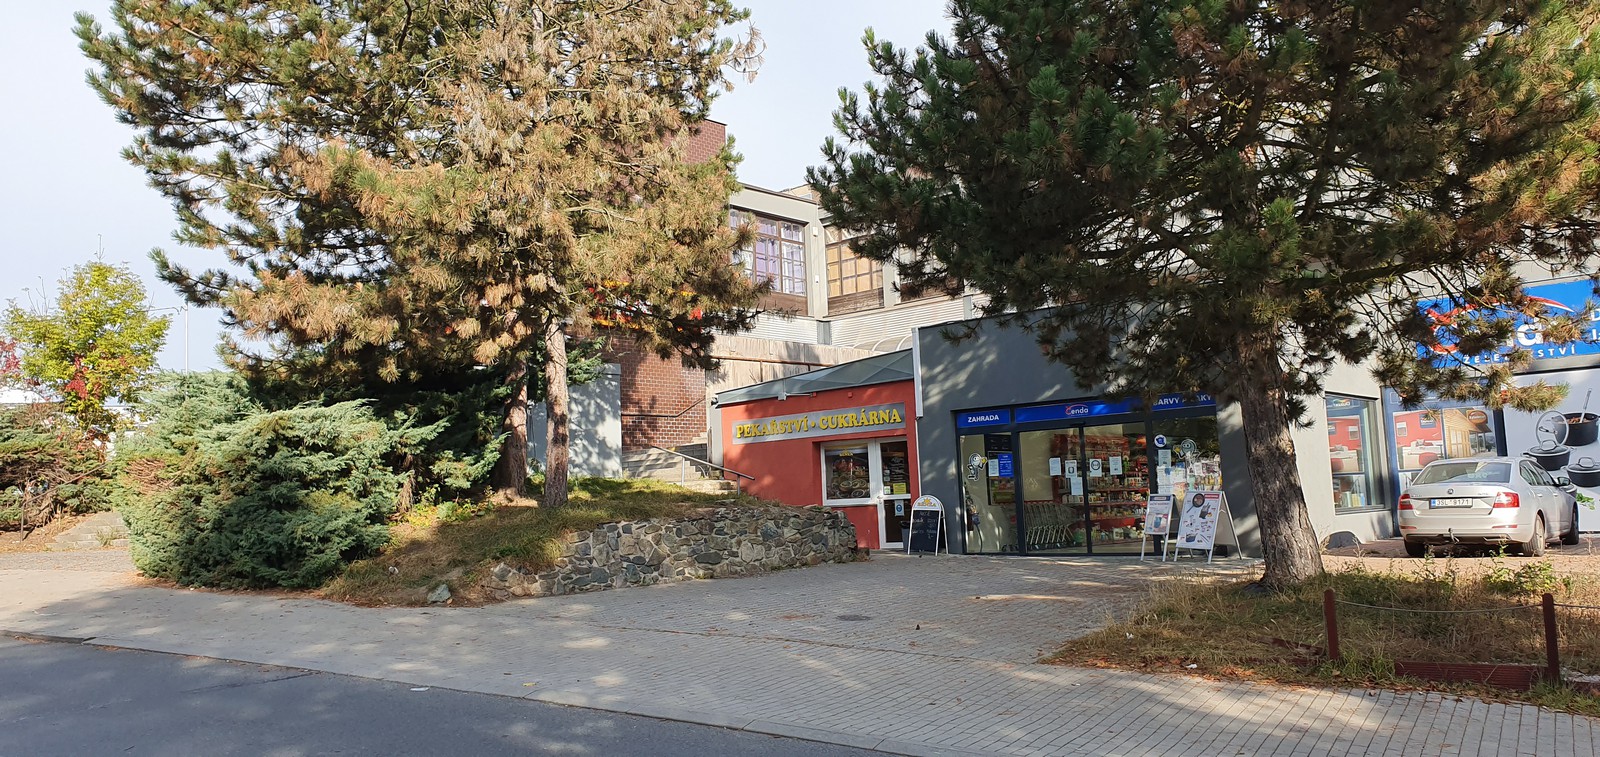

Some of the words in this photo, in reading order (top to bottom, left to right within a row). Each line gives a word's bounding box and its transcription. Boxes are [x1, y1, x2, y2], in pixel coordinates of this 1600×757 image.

[1463, 344, 1575, 364] ŽELESTVÍ
[1153, 397, 1180, 406] ARVY
[736, 416, 808, 438] PEKAŘSTVÍ
[819, 409, 901, 430] CUKRÁRNA
[968, 414, 999, 423] ZAHRADA
